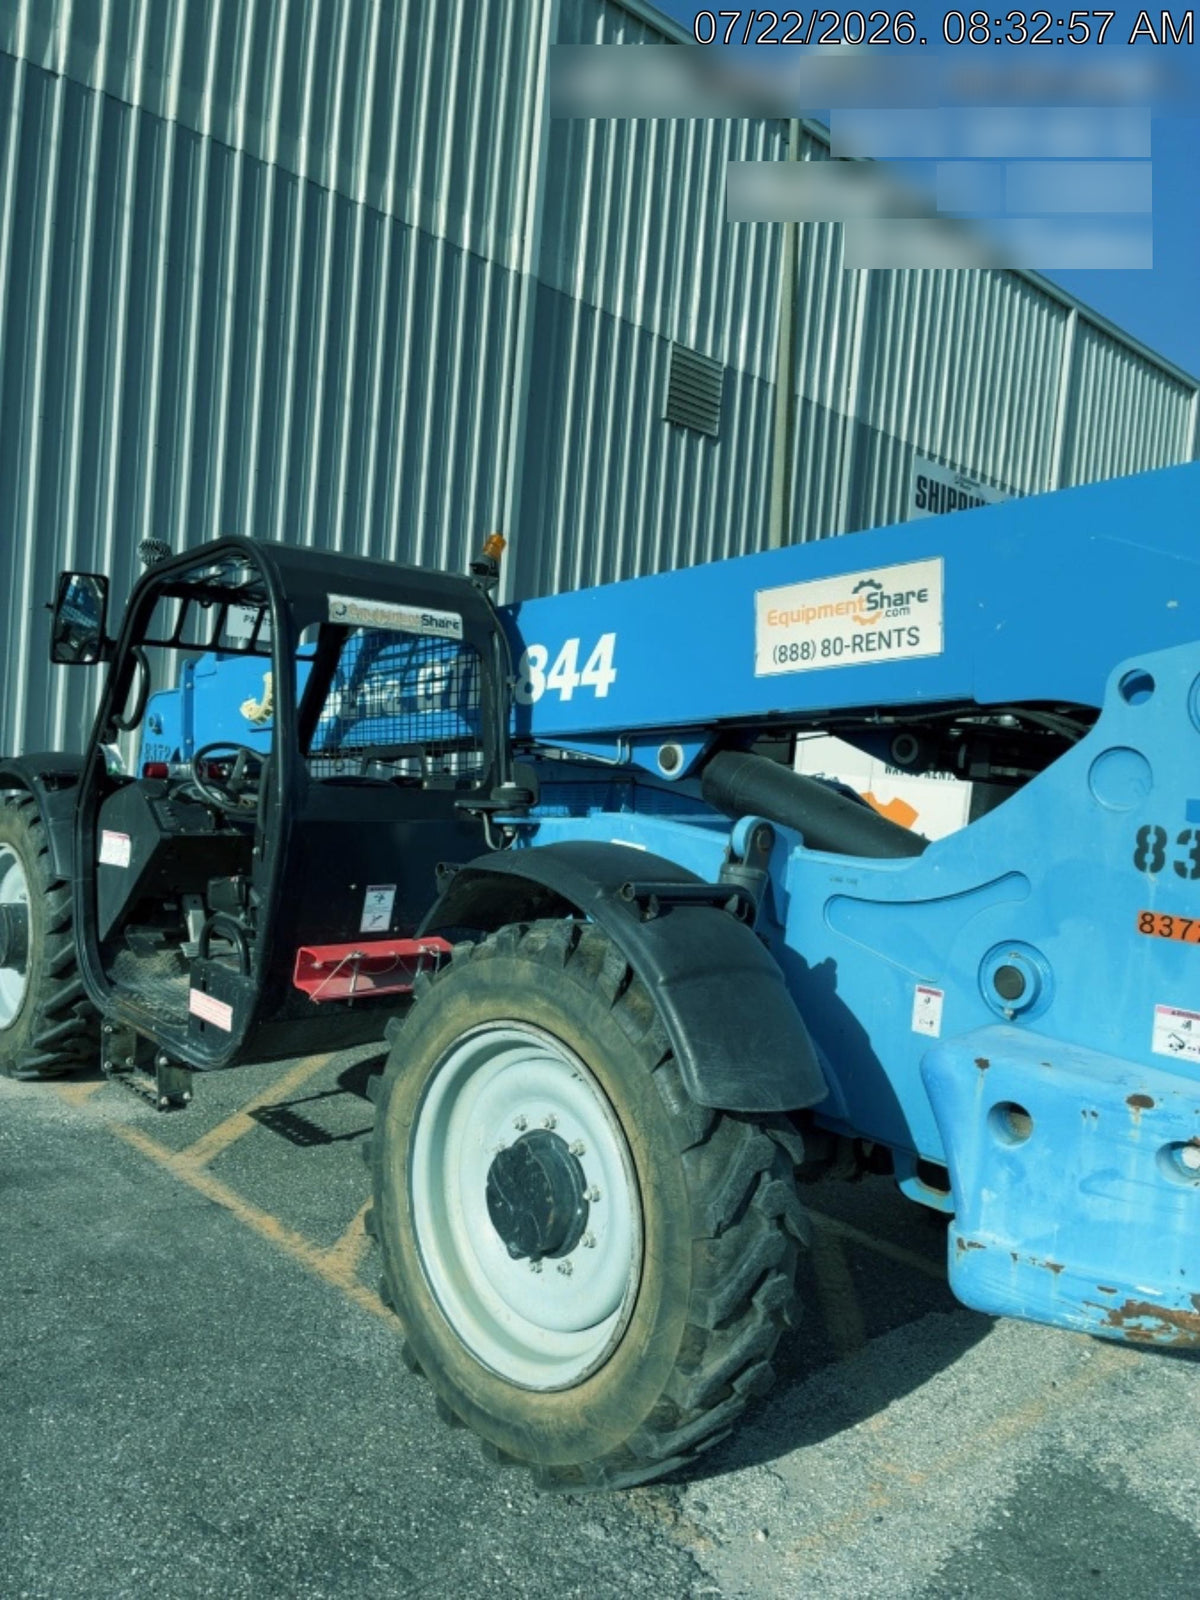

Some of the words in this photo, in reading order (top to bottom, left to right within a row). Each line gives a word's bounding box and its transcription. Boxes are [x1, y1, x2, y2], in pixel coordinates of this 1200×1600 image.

[767, 588, 929, 628] EquipmentShare
[772, 639, 817, 665] (888)
[820, 626, 921, 658] 80-RENTS
[515, 632, 618, 705] 844
[1133, 824, 1200, 880] 83
[1138, 911, 1200, 944] 837
